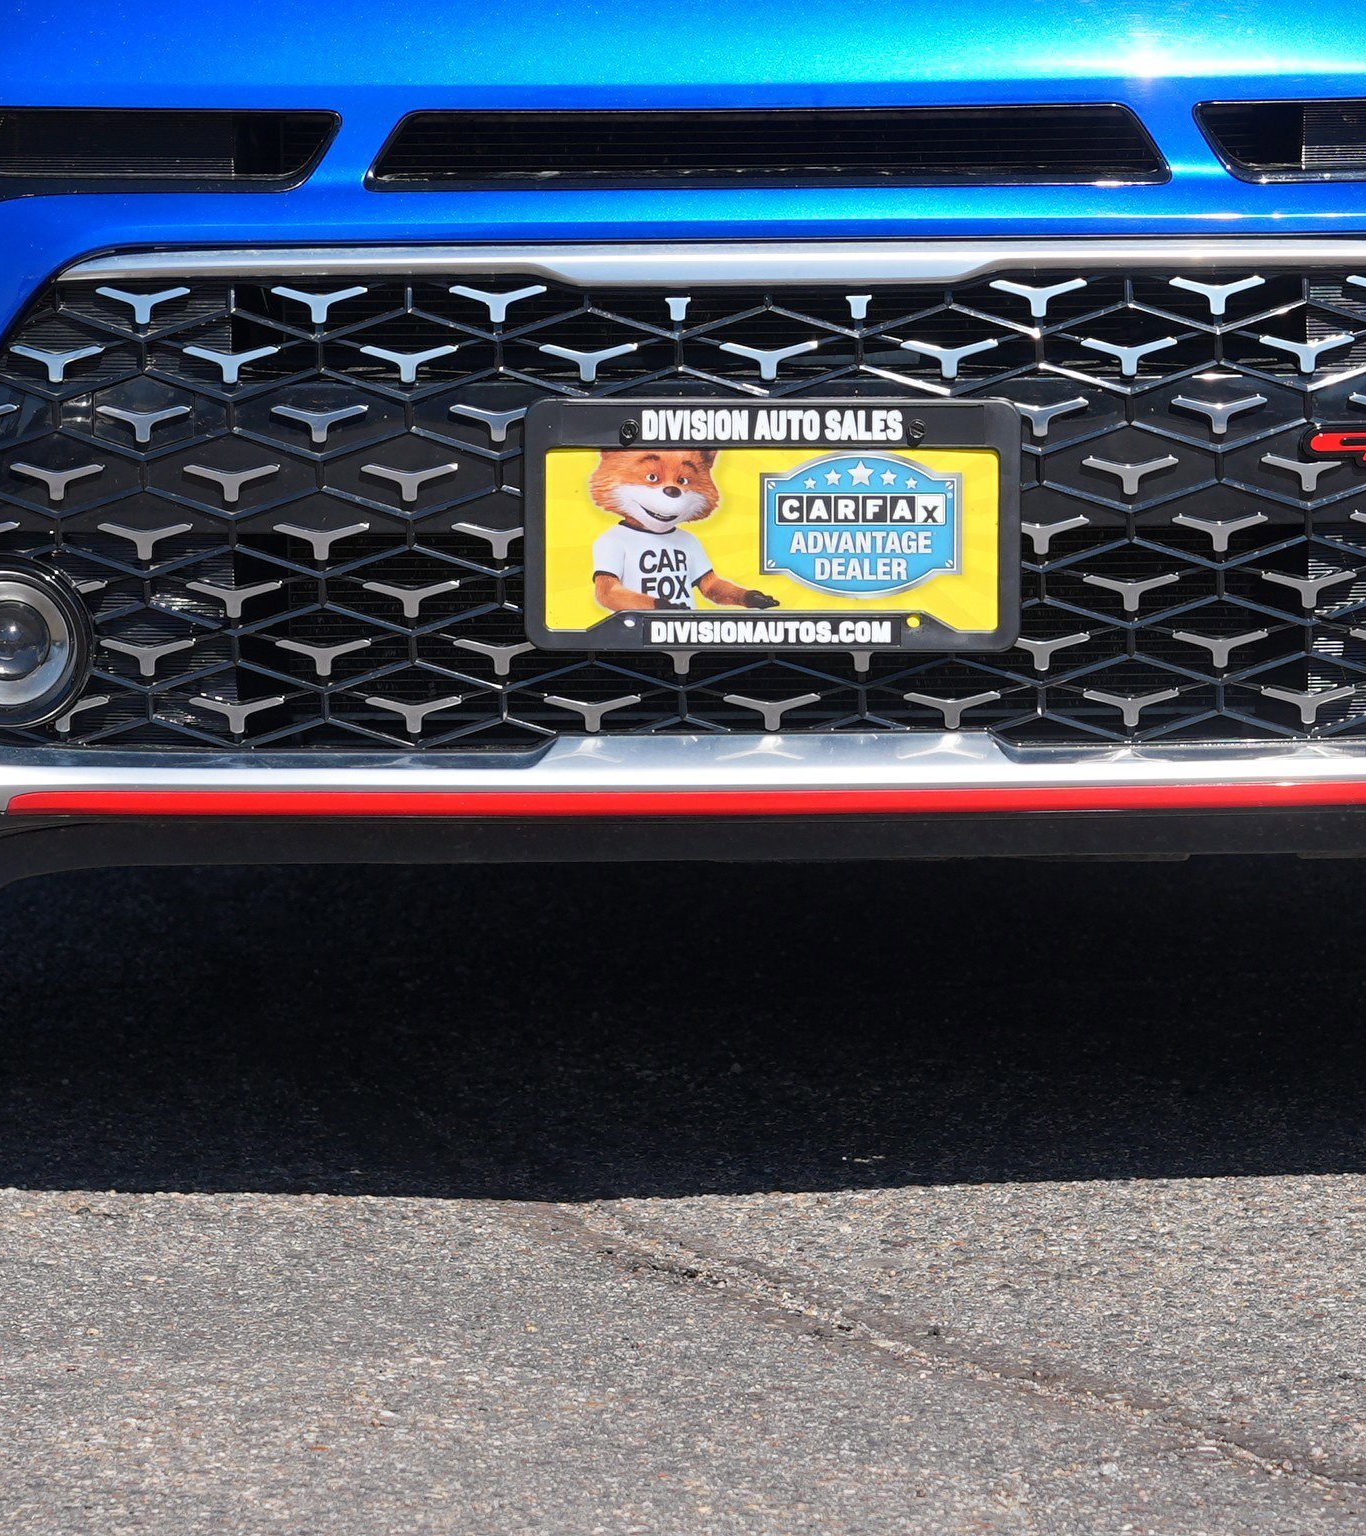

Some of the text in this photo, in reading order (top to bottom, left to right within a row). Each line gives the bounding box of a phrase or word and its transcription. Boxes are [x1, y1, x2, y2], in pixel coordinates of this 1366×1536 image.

[641, 409, 904, 441] DIVISION AUTO SALES
[780, 496, 941, 524] CARFAX
[790, 531, 933, 554] ADVANTAGE
[639, 549, 688, 574] CAR
[814, 557, 909, 581] DEALER
[641, 575, 691, 600] FOX
[650, 620, 892, 644] DIVISIONAUTOS.COM
